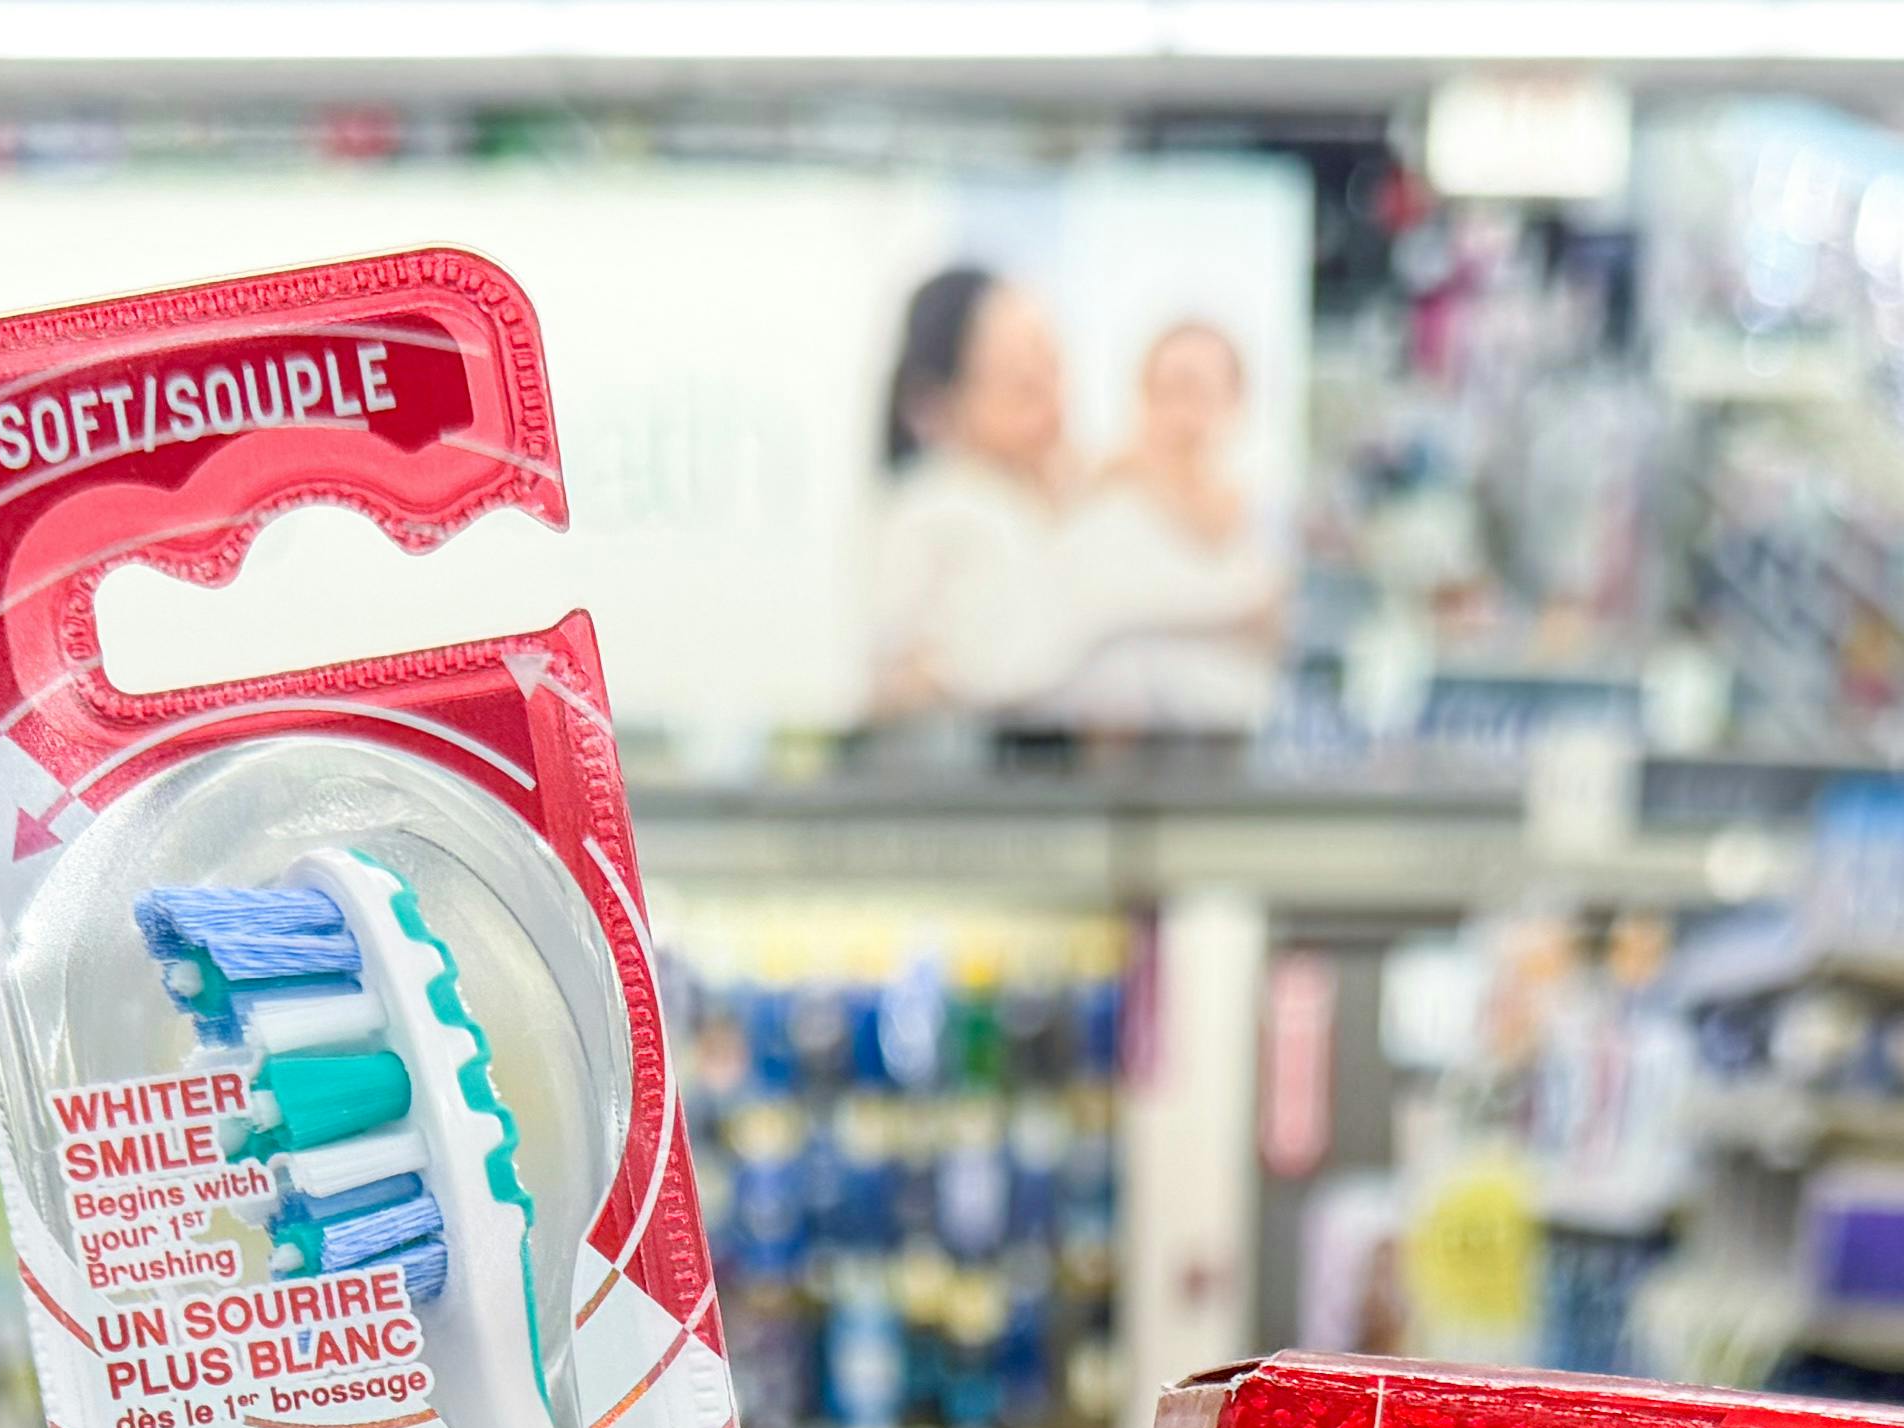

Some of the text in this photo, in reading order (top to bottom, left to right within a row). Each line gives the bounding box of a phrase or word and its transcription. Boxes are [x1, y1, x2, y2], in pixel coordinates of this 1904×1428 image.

[52, 1072, 247, 1135] WHITER
[64, 1125, 218, 1183] SMILE
[73, 1167, 271, 1222] Begins with
[80, 1226, 158, 1262] your
[86, 1246, 236, 1290] Brushing
[97, 1271, 405, 1353] UN SOURIRE
[106, 1318, 418, 1401] PLUS BLANC
[185, 1398, 215, 1427] le
[272, 1368, 429, 1416] brossage
